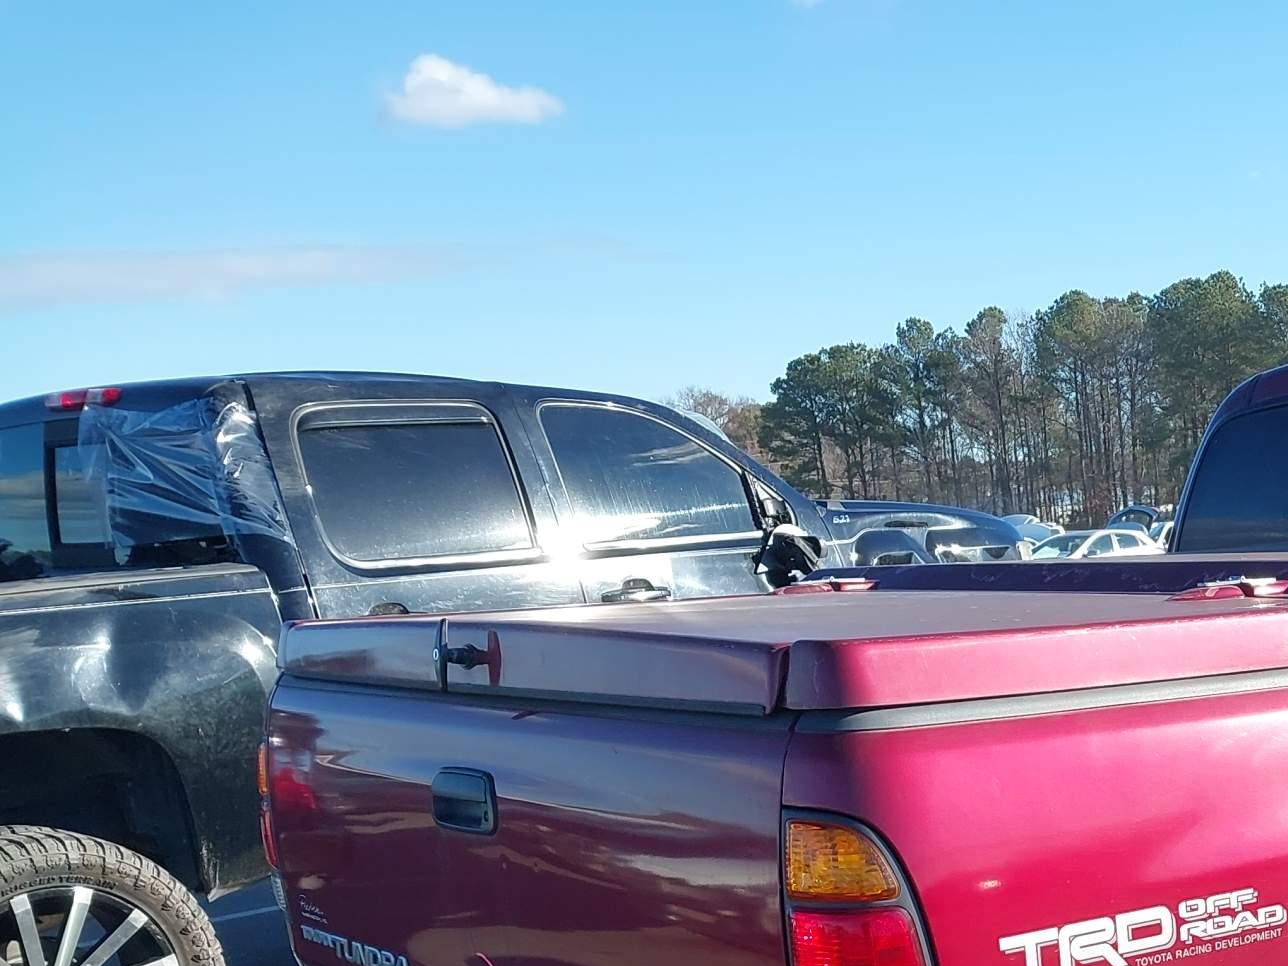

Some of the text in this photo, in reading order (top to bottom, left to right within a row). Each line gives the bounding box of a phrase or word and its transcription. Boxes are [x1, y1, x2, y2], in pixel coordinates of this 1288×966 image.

[1178, 887, 1260, 921] OFF
[1179, 904, 1288, 945] ROAD
[1176, 943, 1213, 960] RACING
[1214, 927, 1283, 954] DEVELOPMENT
